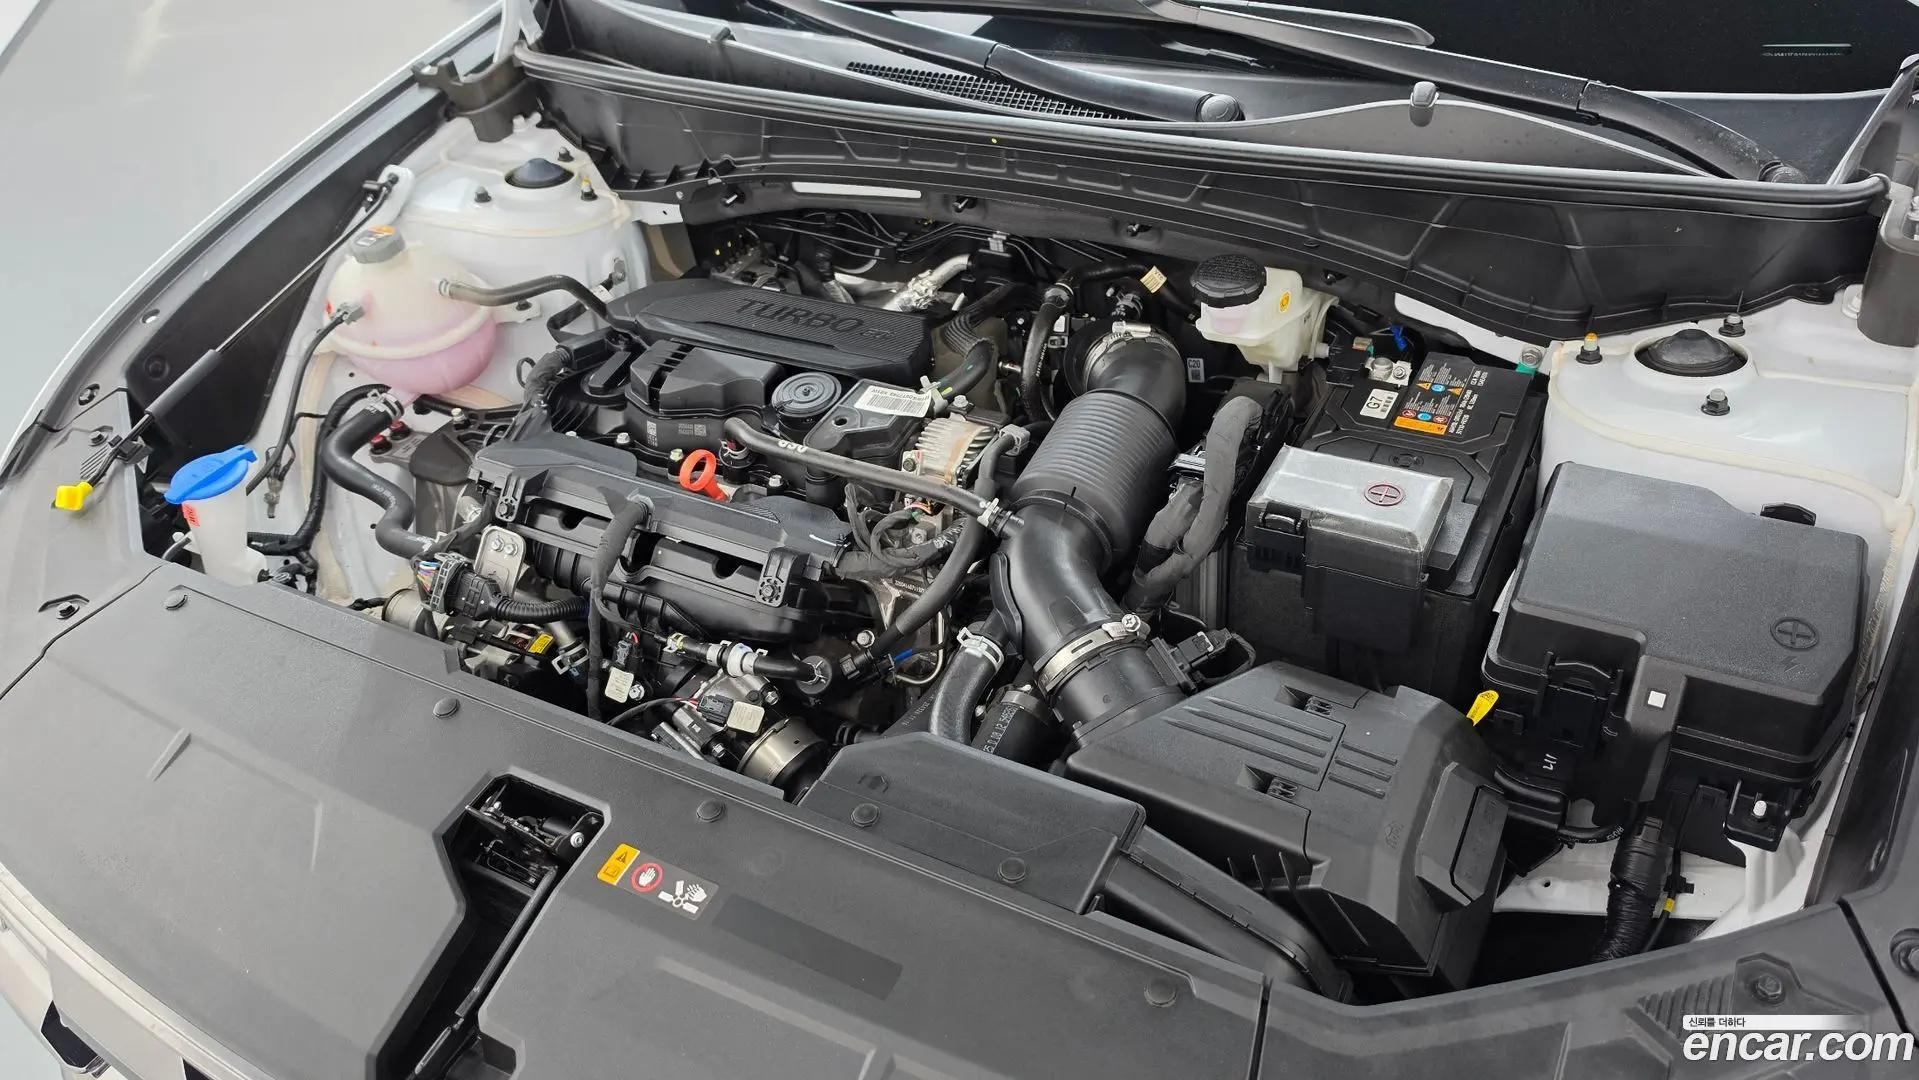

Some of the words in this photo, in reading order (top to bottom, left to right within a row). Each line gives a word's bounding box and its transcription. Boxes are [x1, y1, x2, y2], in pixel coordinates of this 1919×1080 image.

[736, 300, 864, 331] TURBO
[1188, 360, 1200, 368] C20
[1366, 396, 1382, 409] G7
